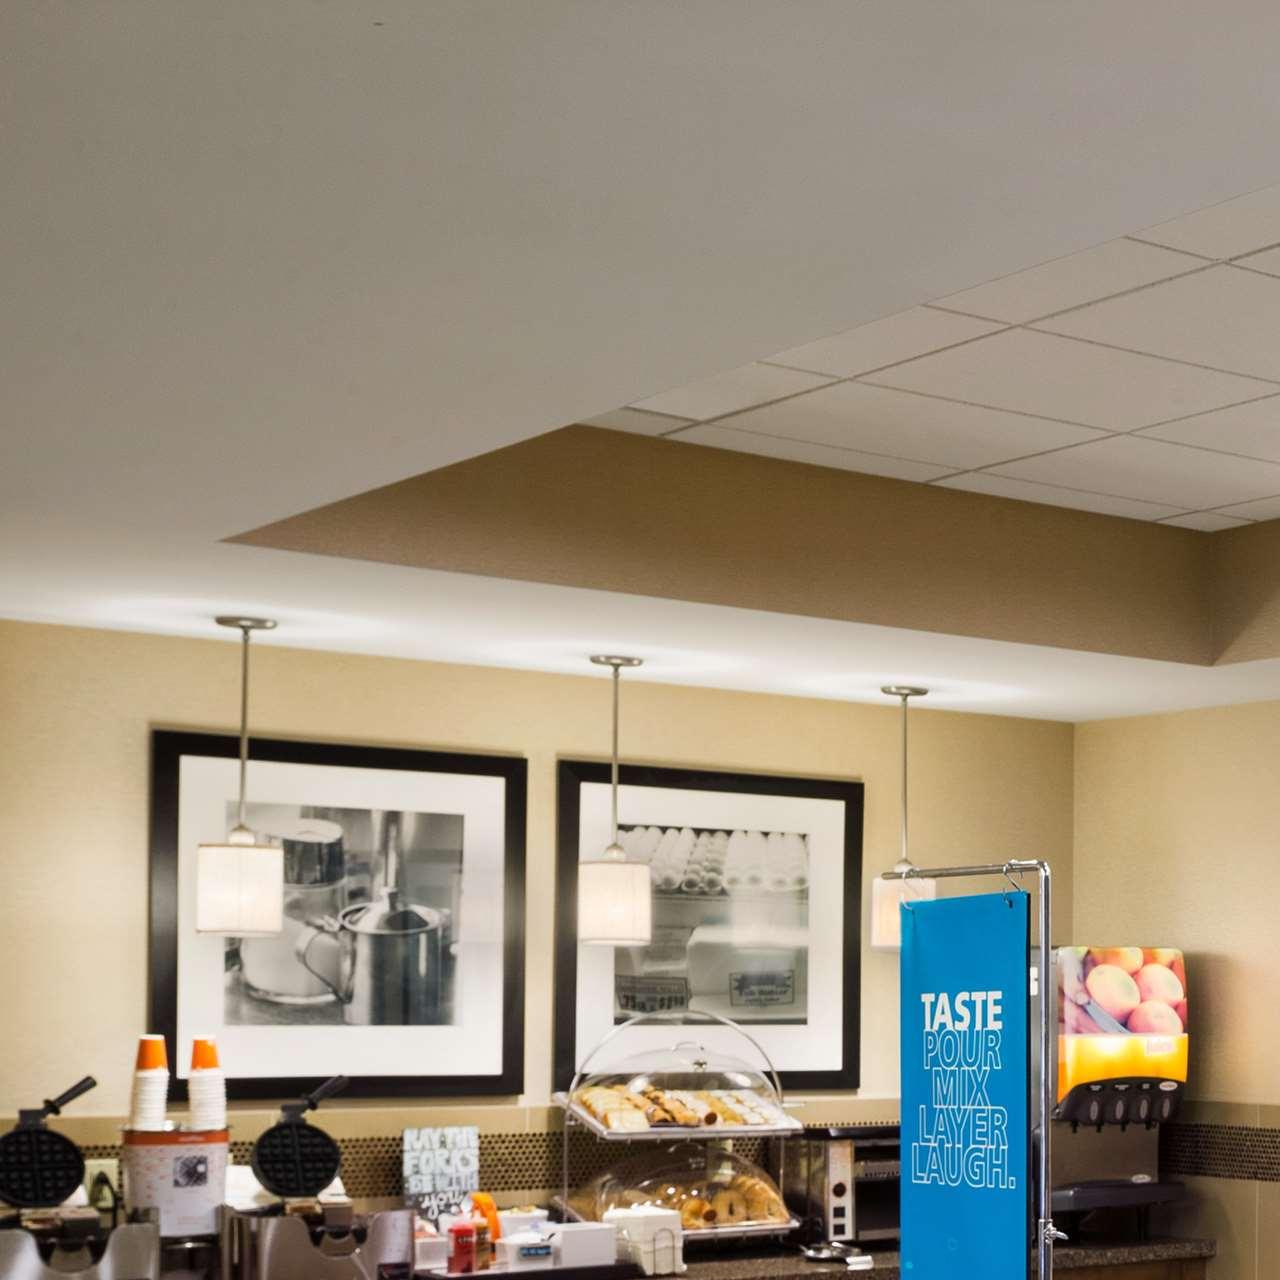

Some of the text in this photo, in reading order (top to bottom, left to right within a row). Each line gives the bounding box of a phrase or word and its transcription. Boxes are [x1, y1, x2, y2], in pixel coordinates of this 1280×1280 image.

[921, 990, 1003, 1031] TASTE
[923, 1028, 1002, 1070] POUR
[932, 1067, 991, 1109] MIX
[919, 1105, 1009, 1149] LAYER
[911, 1142, 1016, 1189] LAUGH.
